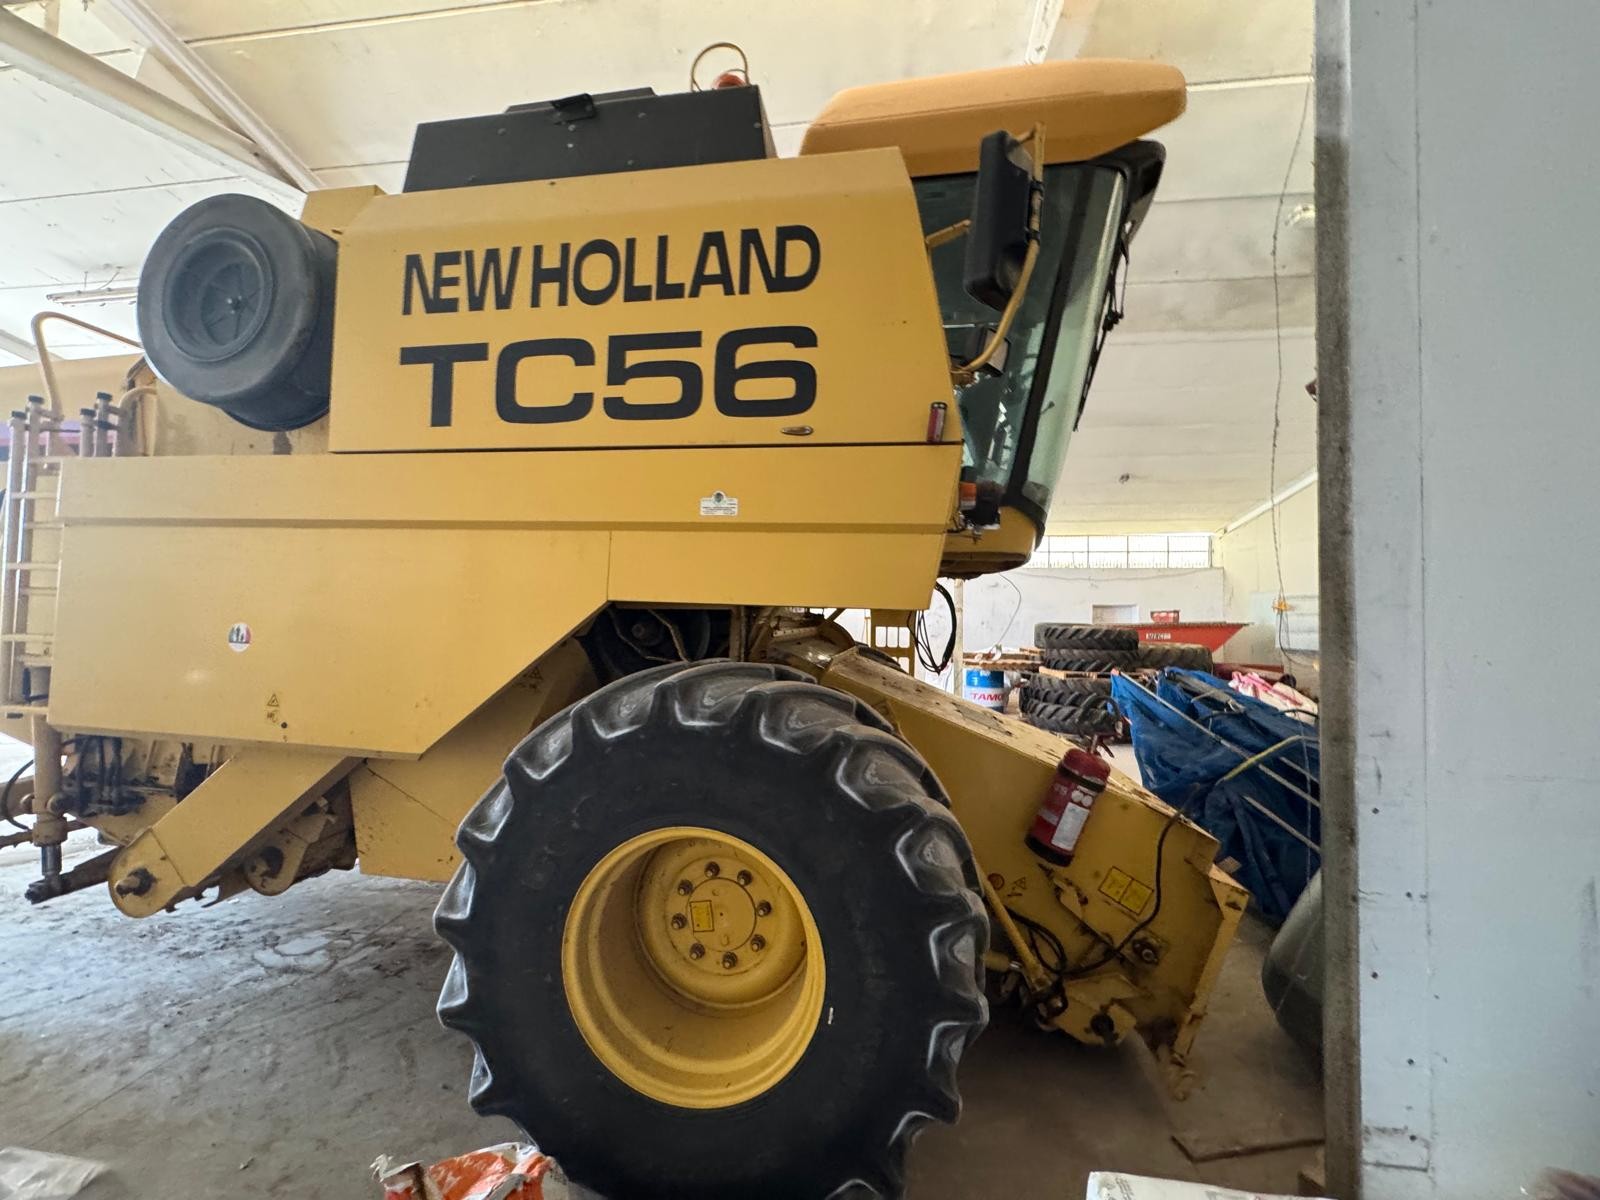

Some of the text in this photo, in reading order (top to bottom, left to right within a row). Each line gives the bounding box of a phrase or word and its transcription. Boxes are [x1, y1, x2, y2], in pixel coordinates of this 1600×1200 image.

[402, 224, 821, 316] NEW HOLLAND
[400, 325, 819, 428] TC56
